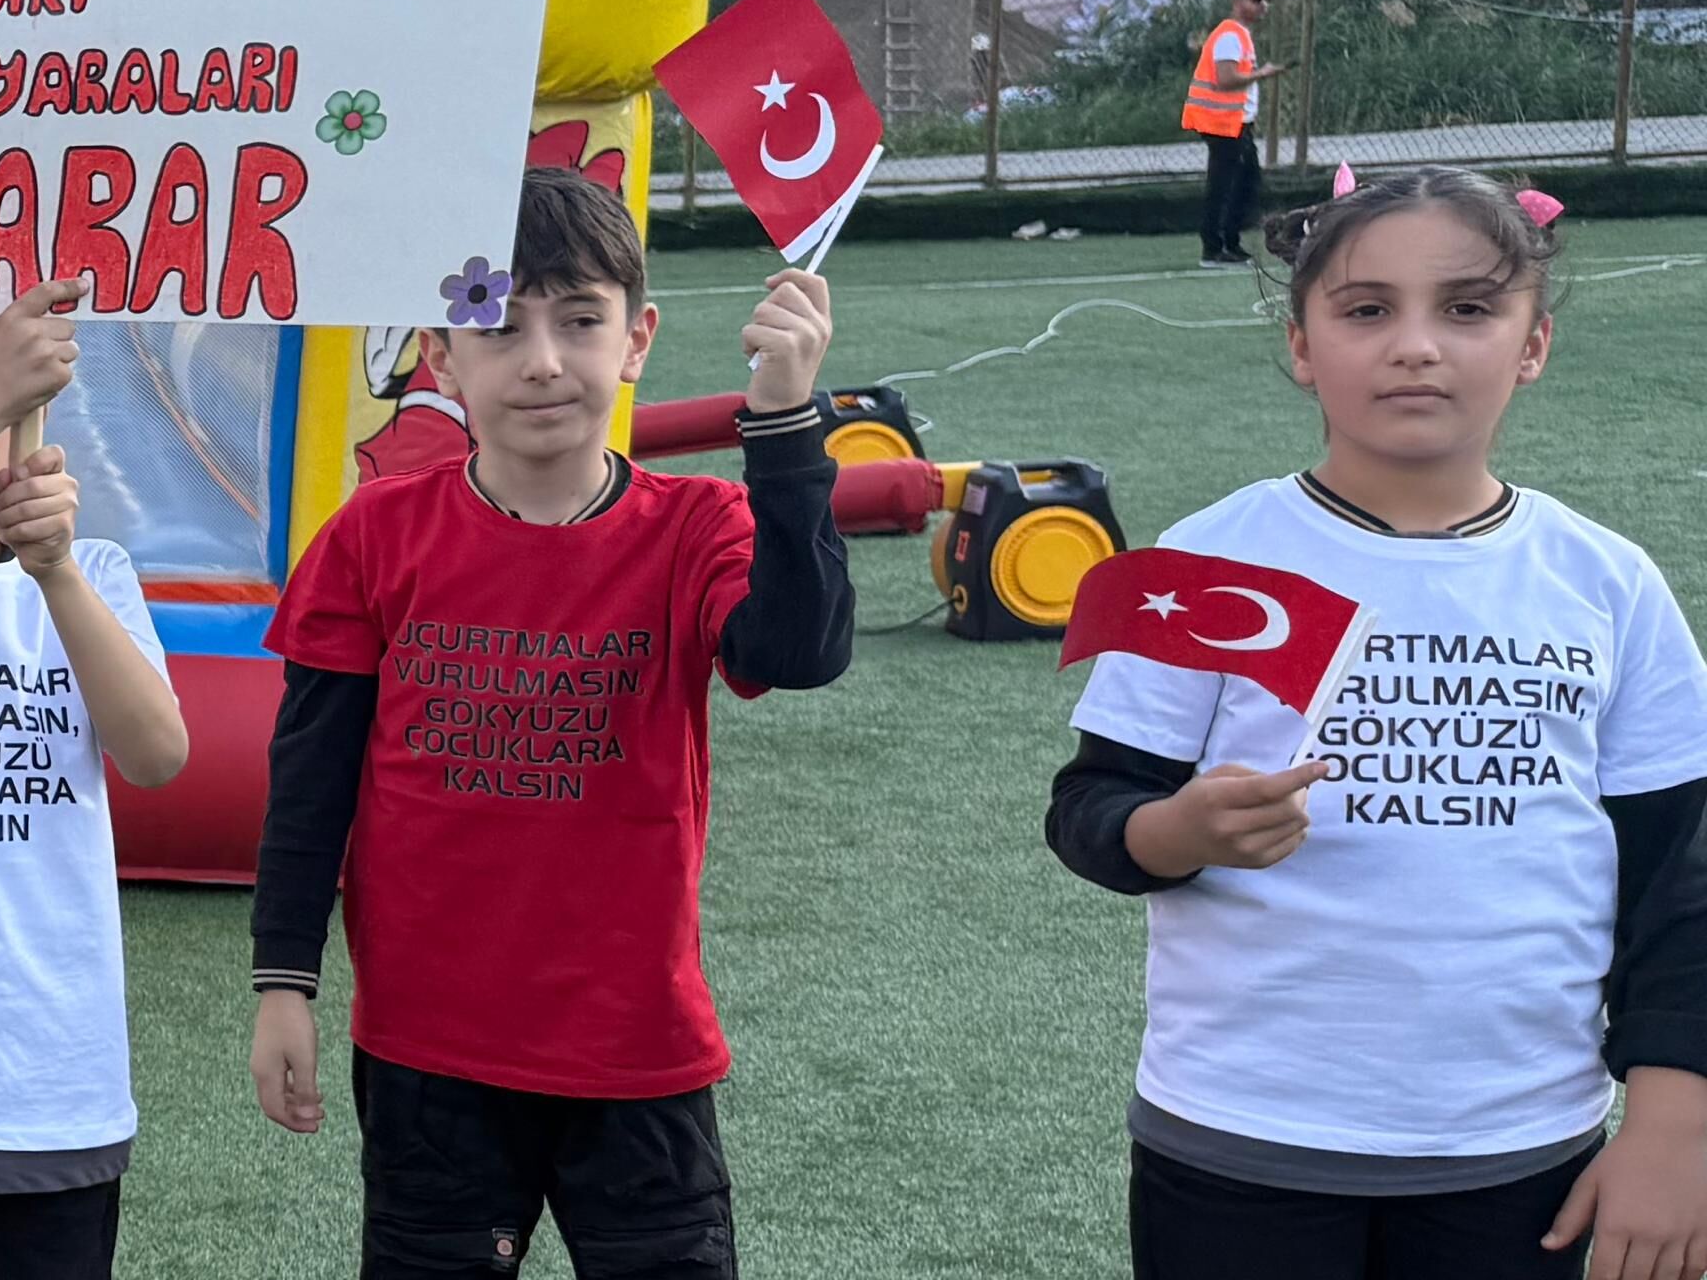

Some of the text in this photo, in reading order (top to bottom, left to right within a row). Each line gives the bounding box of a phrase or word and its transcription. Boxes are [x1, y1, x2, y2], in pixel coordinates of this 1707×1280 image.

[1364, 634, 1595, 677] RTMALAR
[425, 696, 610, 734] GÖKYÜZÜ
[1336, 674, 1586, 721] RULMASIN,
[404, 725, 626, 764] ÇOCUKLARA
[1317, 710, 1542, 749] GÖKYÜZÜ
[443, 765, 582, 801] KALSIN
[1290, 751, 1564, 786] OCUKLARA
[1345, 793, 1517, 826] KALSIN
